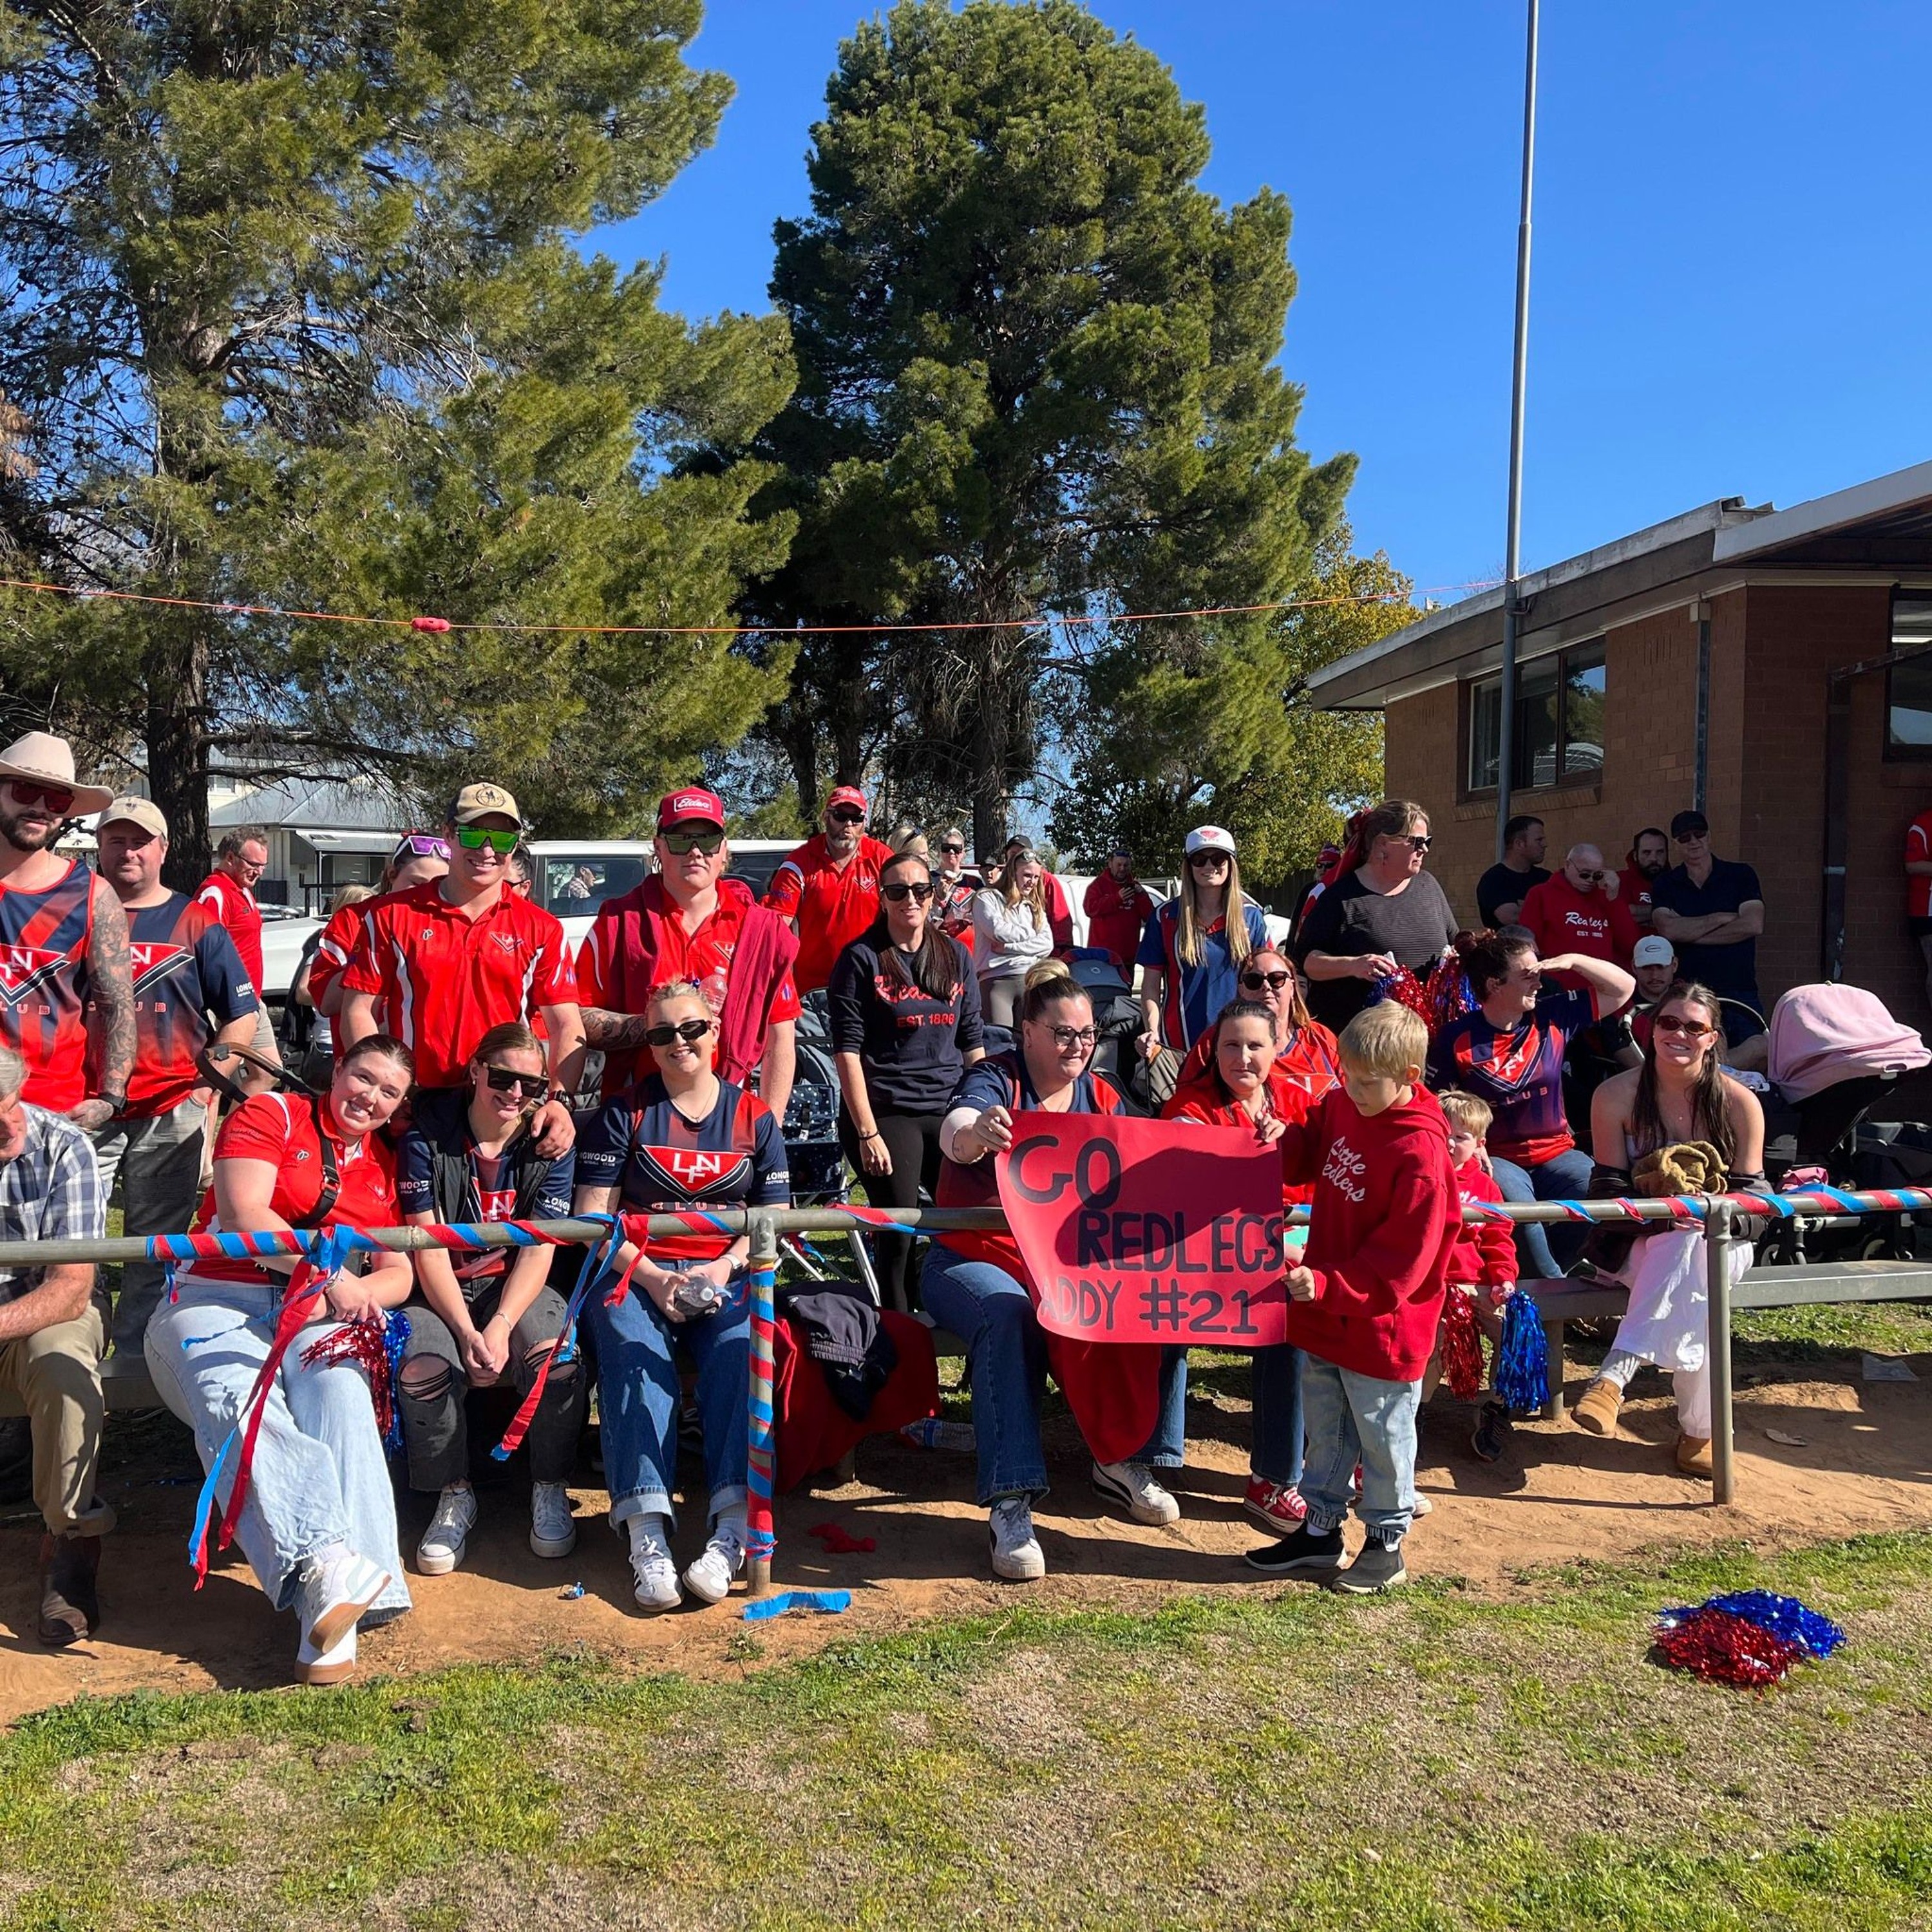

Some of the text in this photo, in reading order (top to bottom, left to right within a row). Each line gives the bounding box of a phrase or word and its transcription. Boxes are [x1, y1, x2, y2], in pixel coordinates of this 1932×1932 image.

[1007, 1135, 1122, 1209] GO
[1077, 1208, 1284, 1273] REDLEGS
[1139, 1278, 1259, 1334] #21
